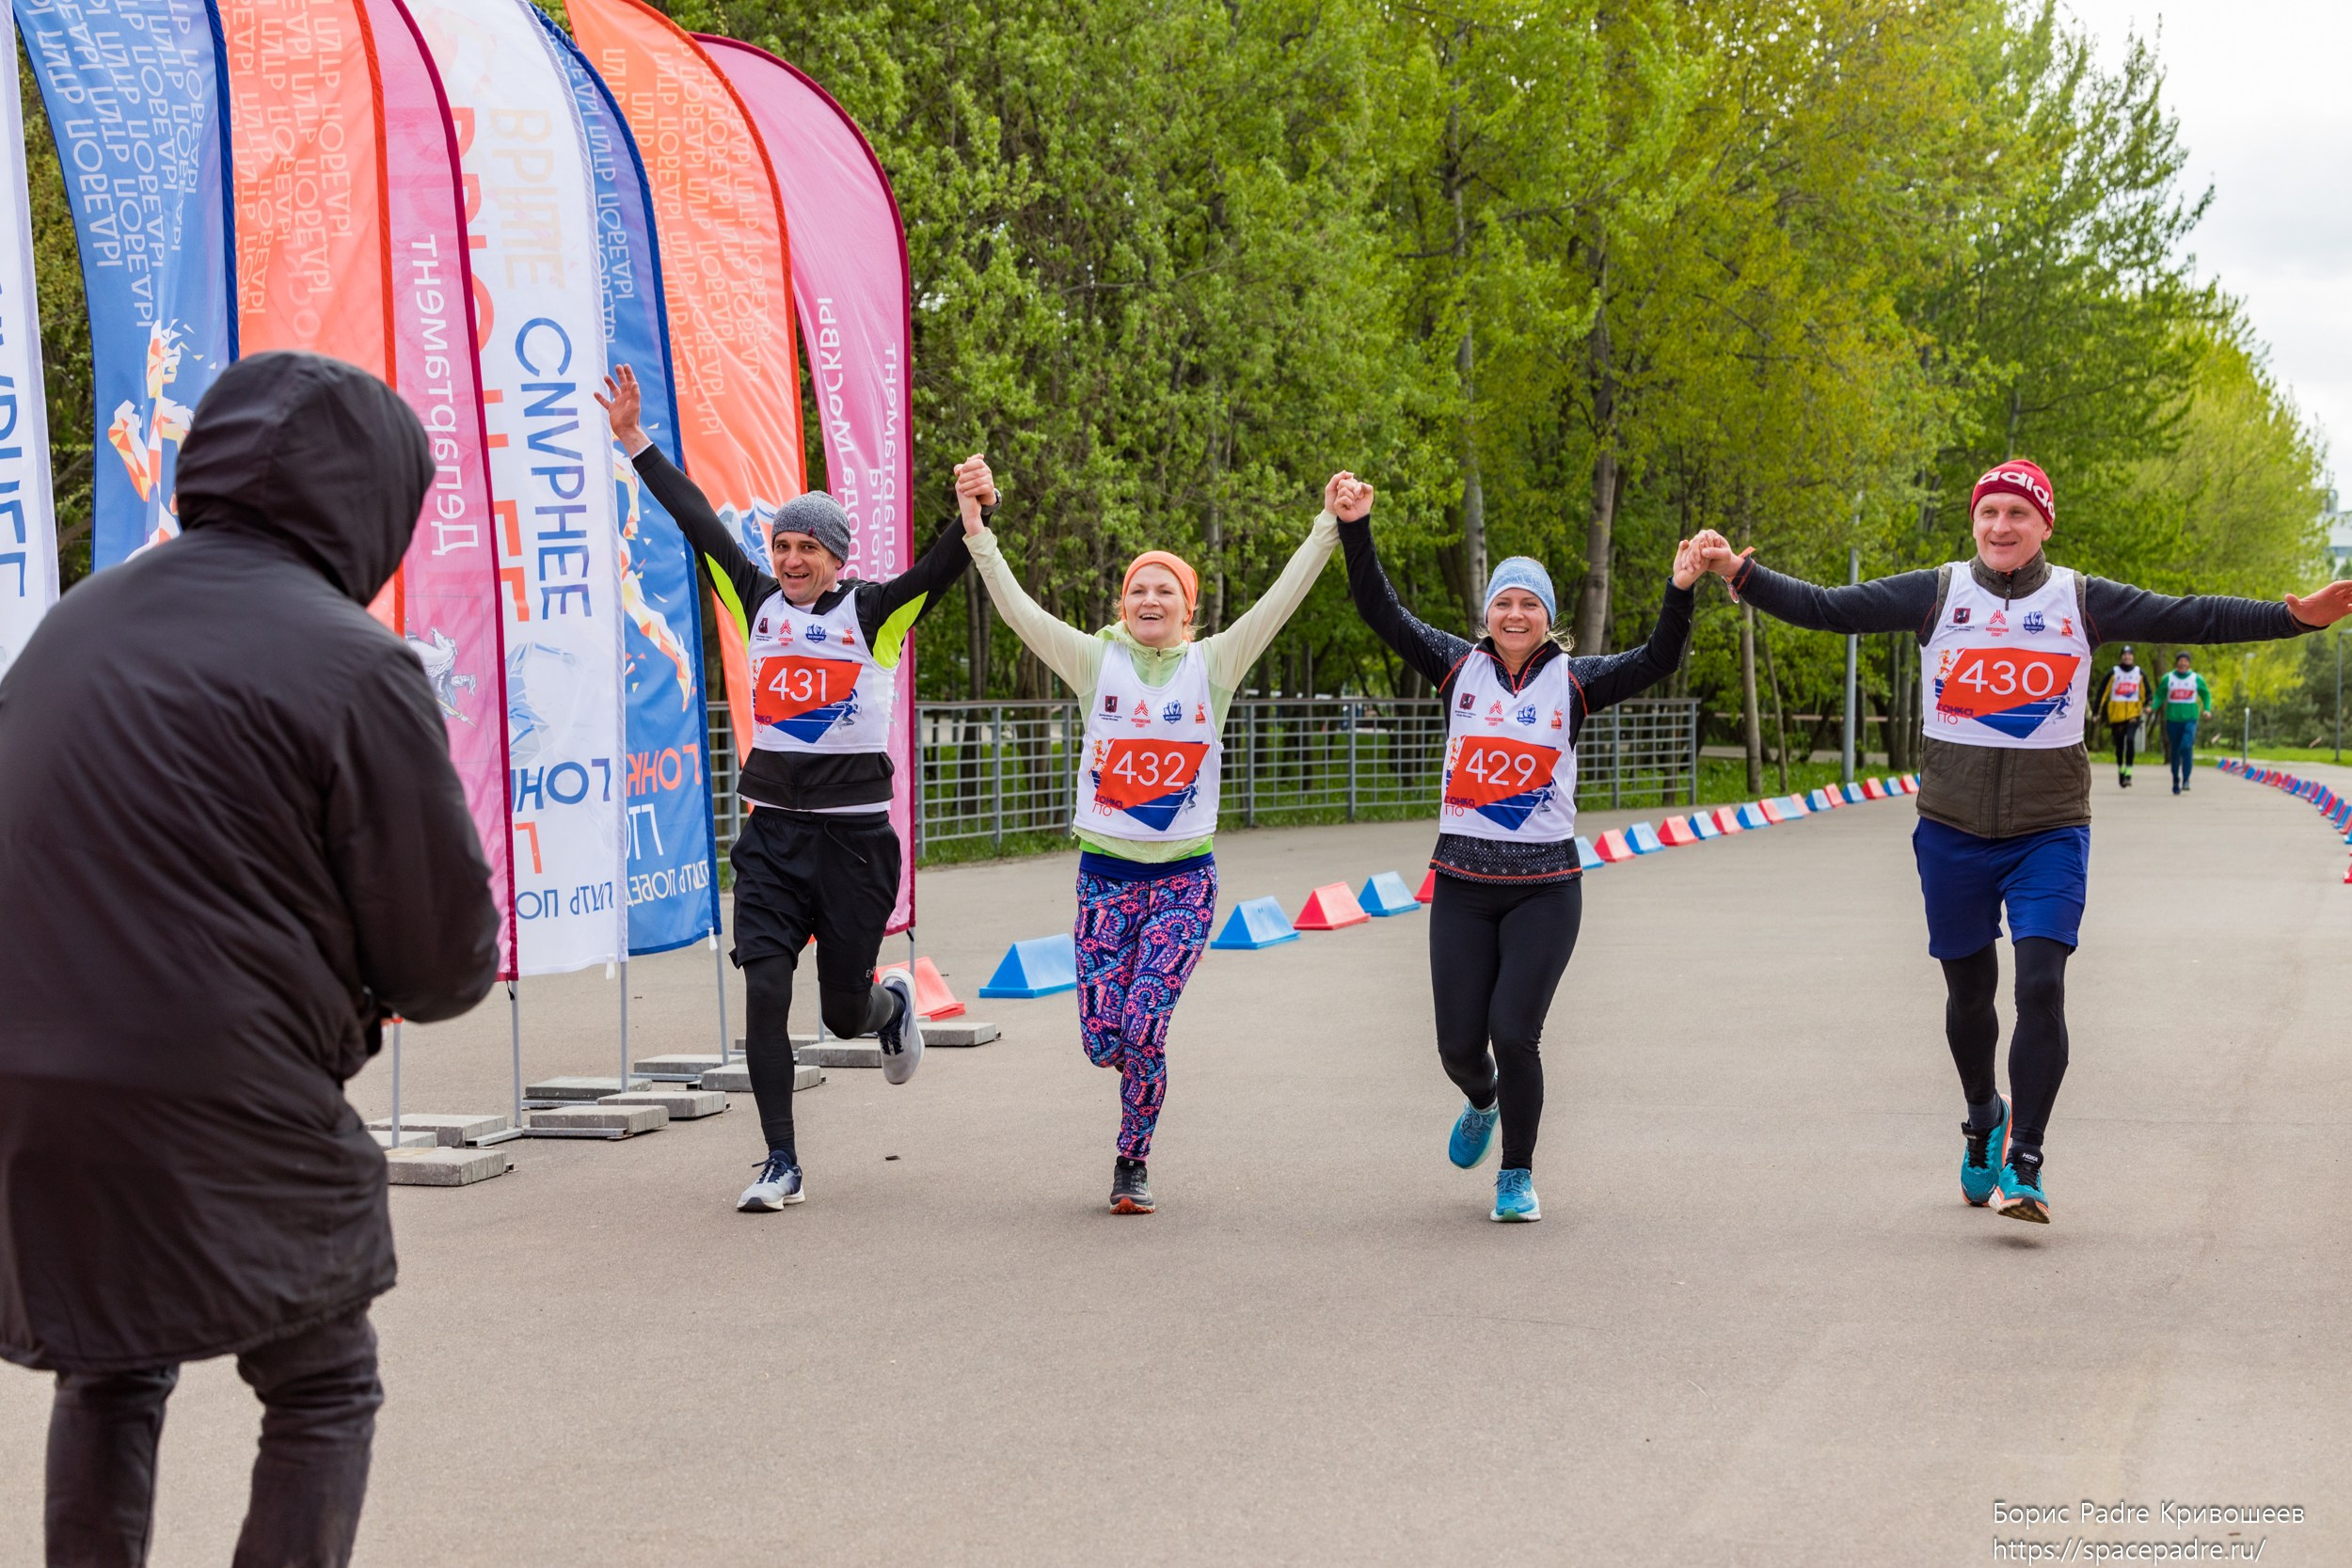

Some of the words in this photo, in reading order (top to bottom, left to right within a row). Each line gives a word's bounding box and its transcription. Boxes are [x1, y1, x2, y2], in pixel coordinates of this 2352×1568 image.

[1979, 470, 2055, 520] adida
[769, 667, 827, 702] 431
[1958, 659, 2054, 696] 430
[1937, 712, 1959, 725] ГТО
[1112, 751, 1185, 786] 432
[1465, 748, 1537, 786] 429
[1092, 802, 1113, 816] ГТО
[1445, 804, 1464, 816] ГТО
